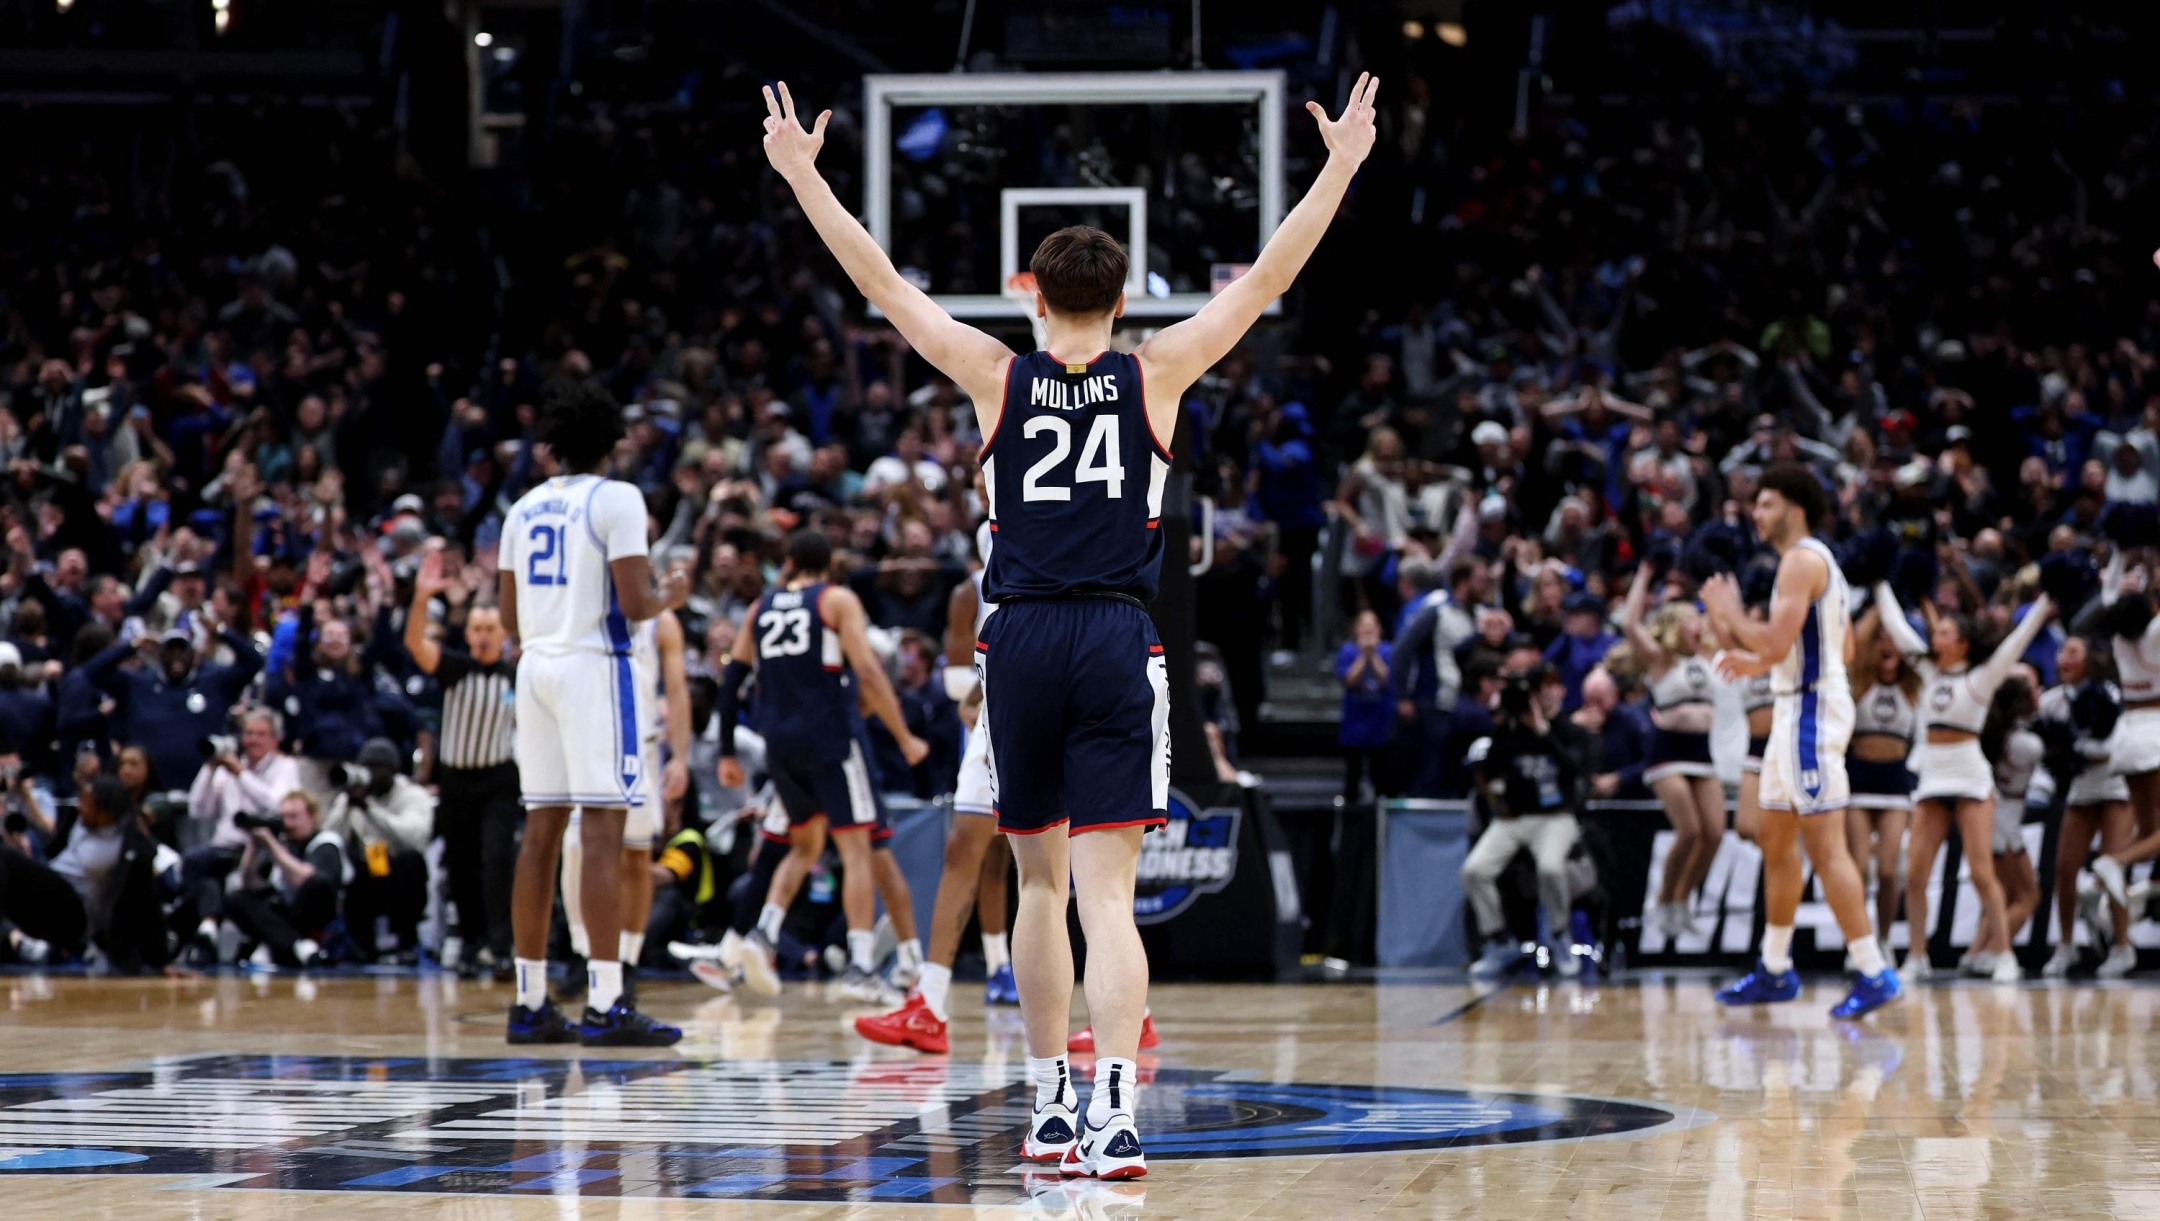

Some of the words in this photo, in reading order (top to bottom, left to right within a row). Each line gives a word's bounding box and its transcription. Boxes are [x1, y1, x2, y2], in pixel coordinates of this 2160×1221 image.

[1031, 375, 1119, 411] MULLINS
[1023, 414, 1125, 502] 24
[528, 525, 567, 585] 21
[758, 608, 811, 659] 23
